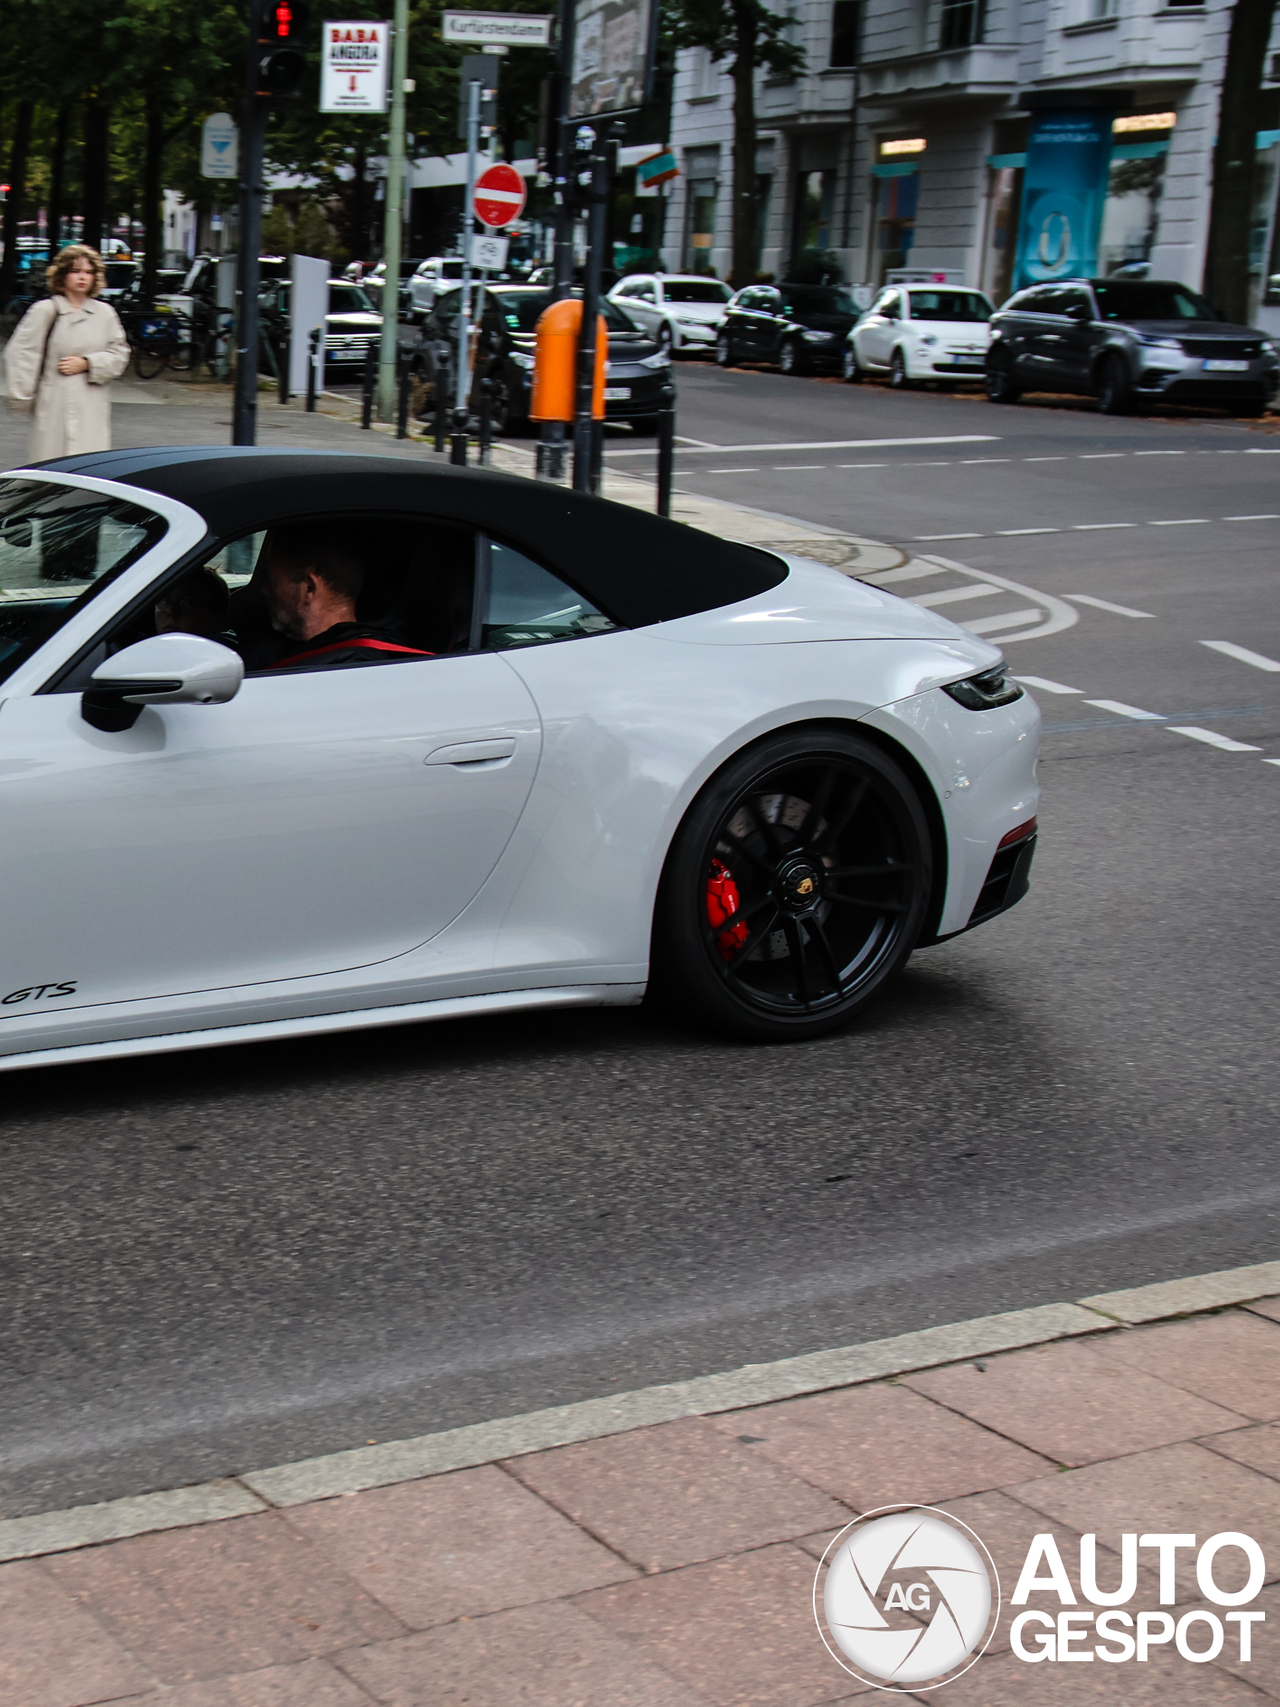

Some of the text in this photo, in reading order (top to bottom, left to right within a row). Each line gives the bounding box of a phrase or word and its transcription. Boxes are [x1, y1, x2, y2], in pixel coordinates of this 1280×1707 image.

[330, 28, 380, 43] BABA
[329, 45, 379, 59] ANGORA
[1, 980, 78, 1004] GTS
